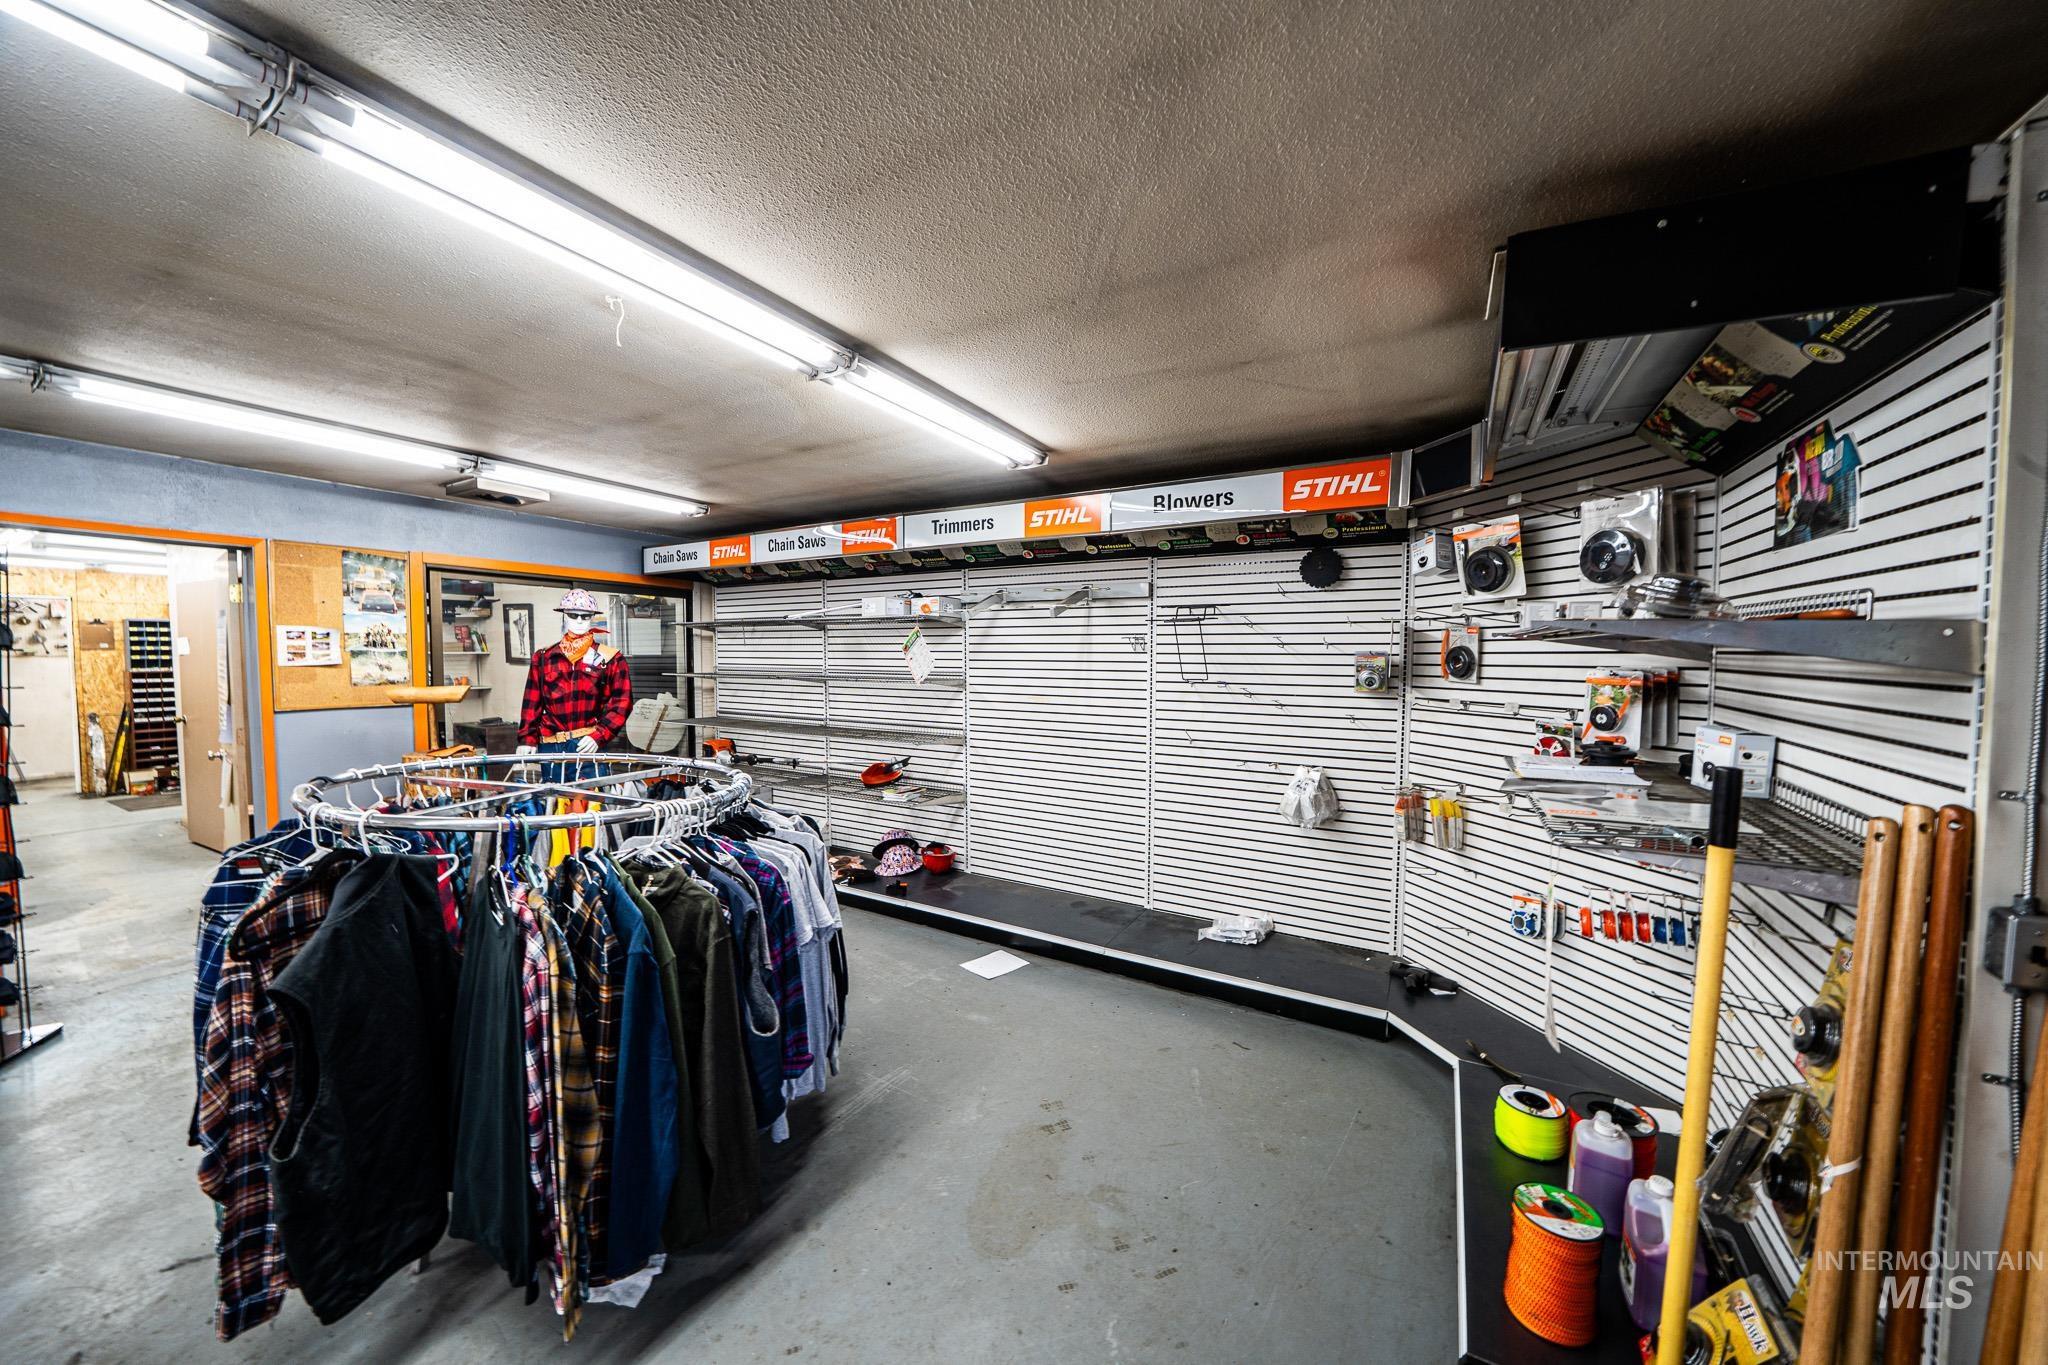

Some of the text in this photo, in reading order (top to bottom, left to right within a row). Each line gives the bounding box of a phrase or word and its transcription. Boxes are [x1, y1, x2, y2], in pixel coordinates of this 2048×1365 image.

[1290, 472, 1382, 500] STIHL
[1153, 491, 1234, 513] Blowers
[932, 516, 994, 535] Trimmers
[1029, 506, 1092, 528] STIHL
[845, 527, 889, 546] STIHL
[1342, 524, 1387, 533] Professional
[713, 544, 745, 559] STIHL
[768, 535, 826, 553] Chain Saws
[653, 549, 698, 565] Chain Saws
